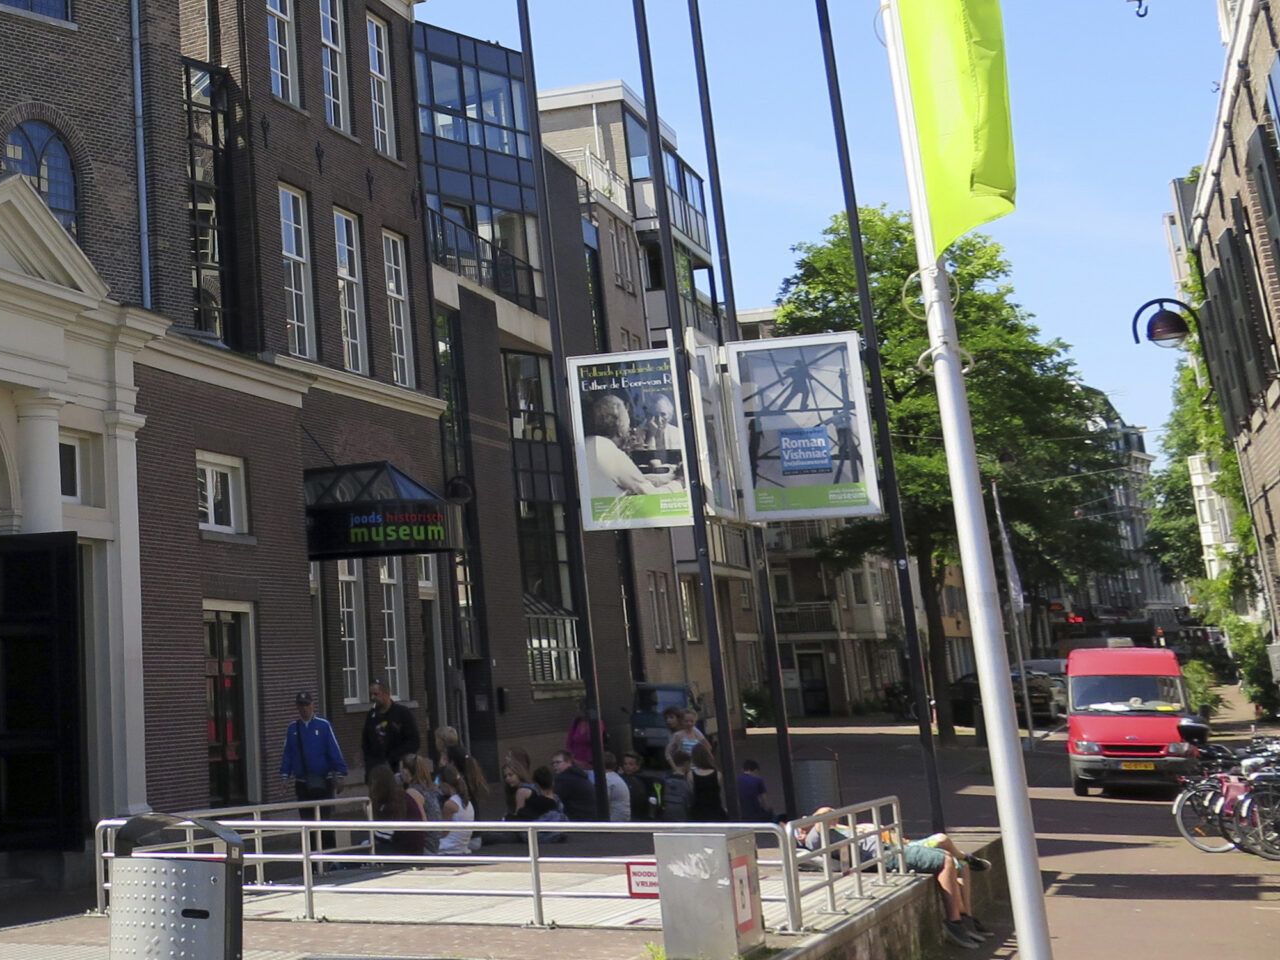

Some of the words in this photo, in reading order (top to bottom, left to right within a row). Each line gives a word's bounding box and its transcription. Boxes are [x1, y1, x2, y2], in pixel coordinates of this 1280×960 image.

[581, 379, 608, 392] Esther
[610, 378, 620, 389] de
[781, 437, 826, 449] Roman
[782, 449, 827, 460] Vishniac
[349, 512, 383, 526] joods
[385, 512, 444, 523] historisch
[350, 524, 445, 542] museum
